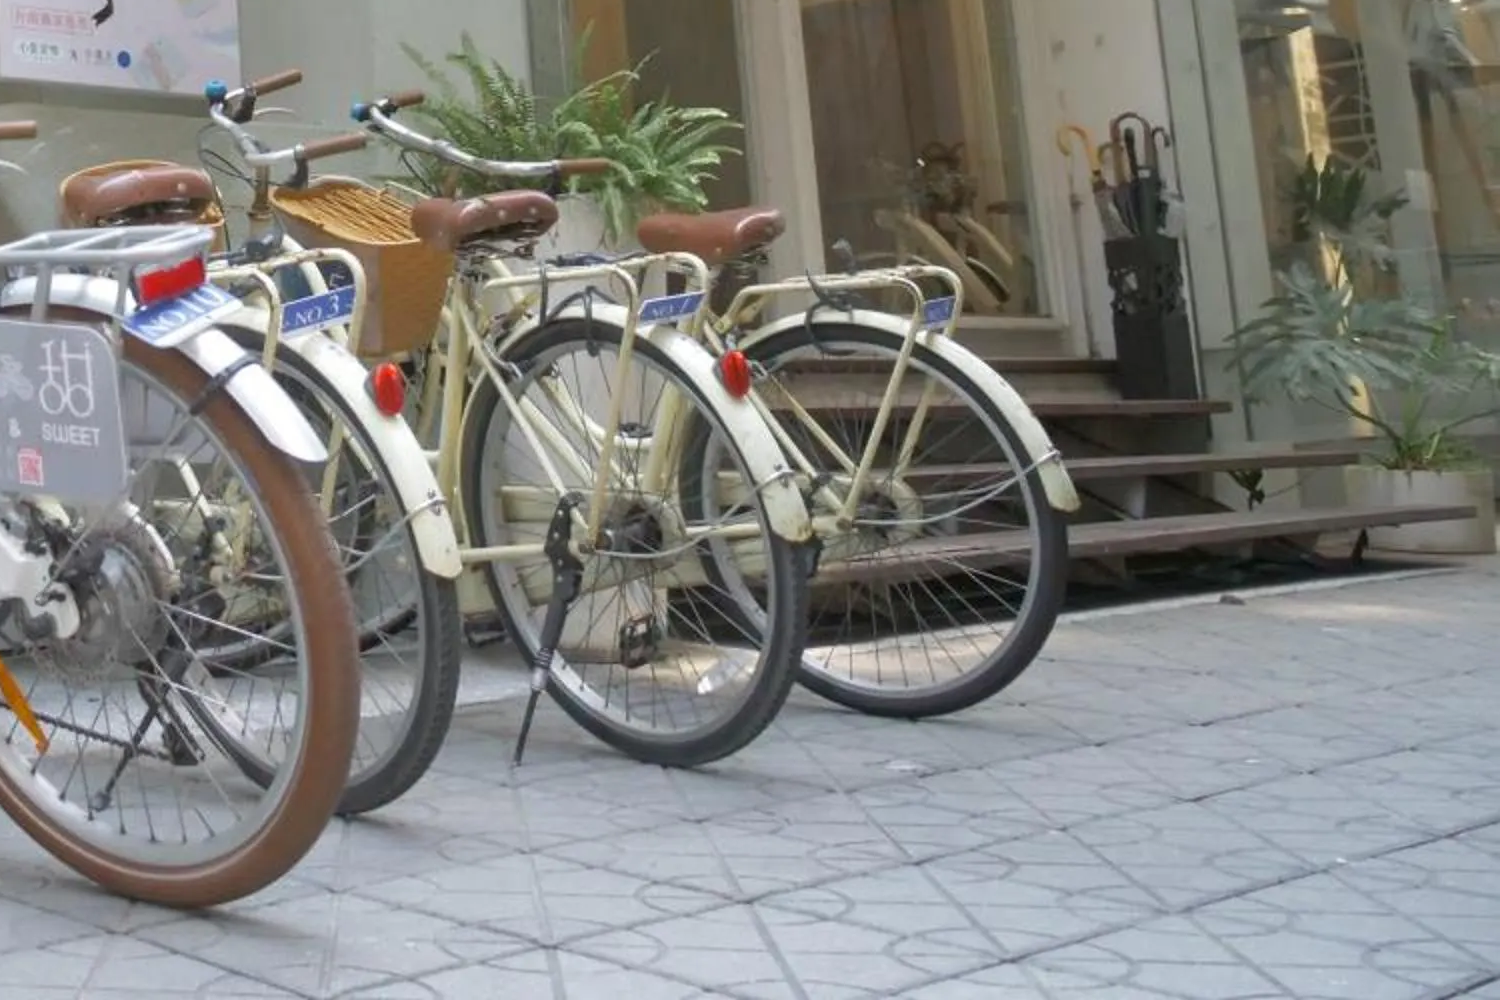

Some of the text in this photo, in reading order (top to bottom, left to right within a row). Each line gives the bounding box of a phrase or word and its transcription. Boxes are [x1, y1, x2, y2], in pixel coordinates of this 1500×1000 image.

[137, 285, 224, 336] NO.10
[294, 294, 340, 326] NO.3
[37, 339, 95, 419] 甜
[8, 416, 22, 439] &
[41, 421, 100, 447] SWEET
